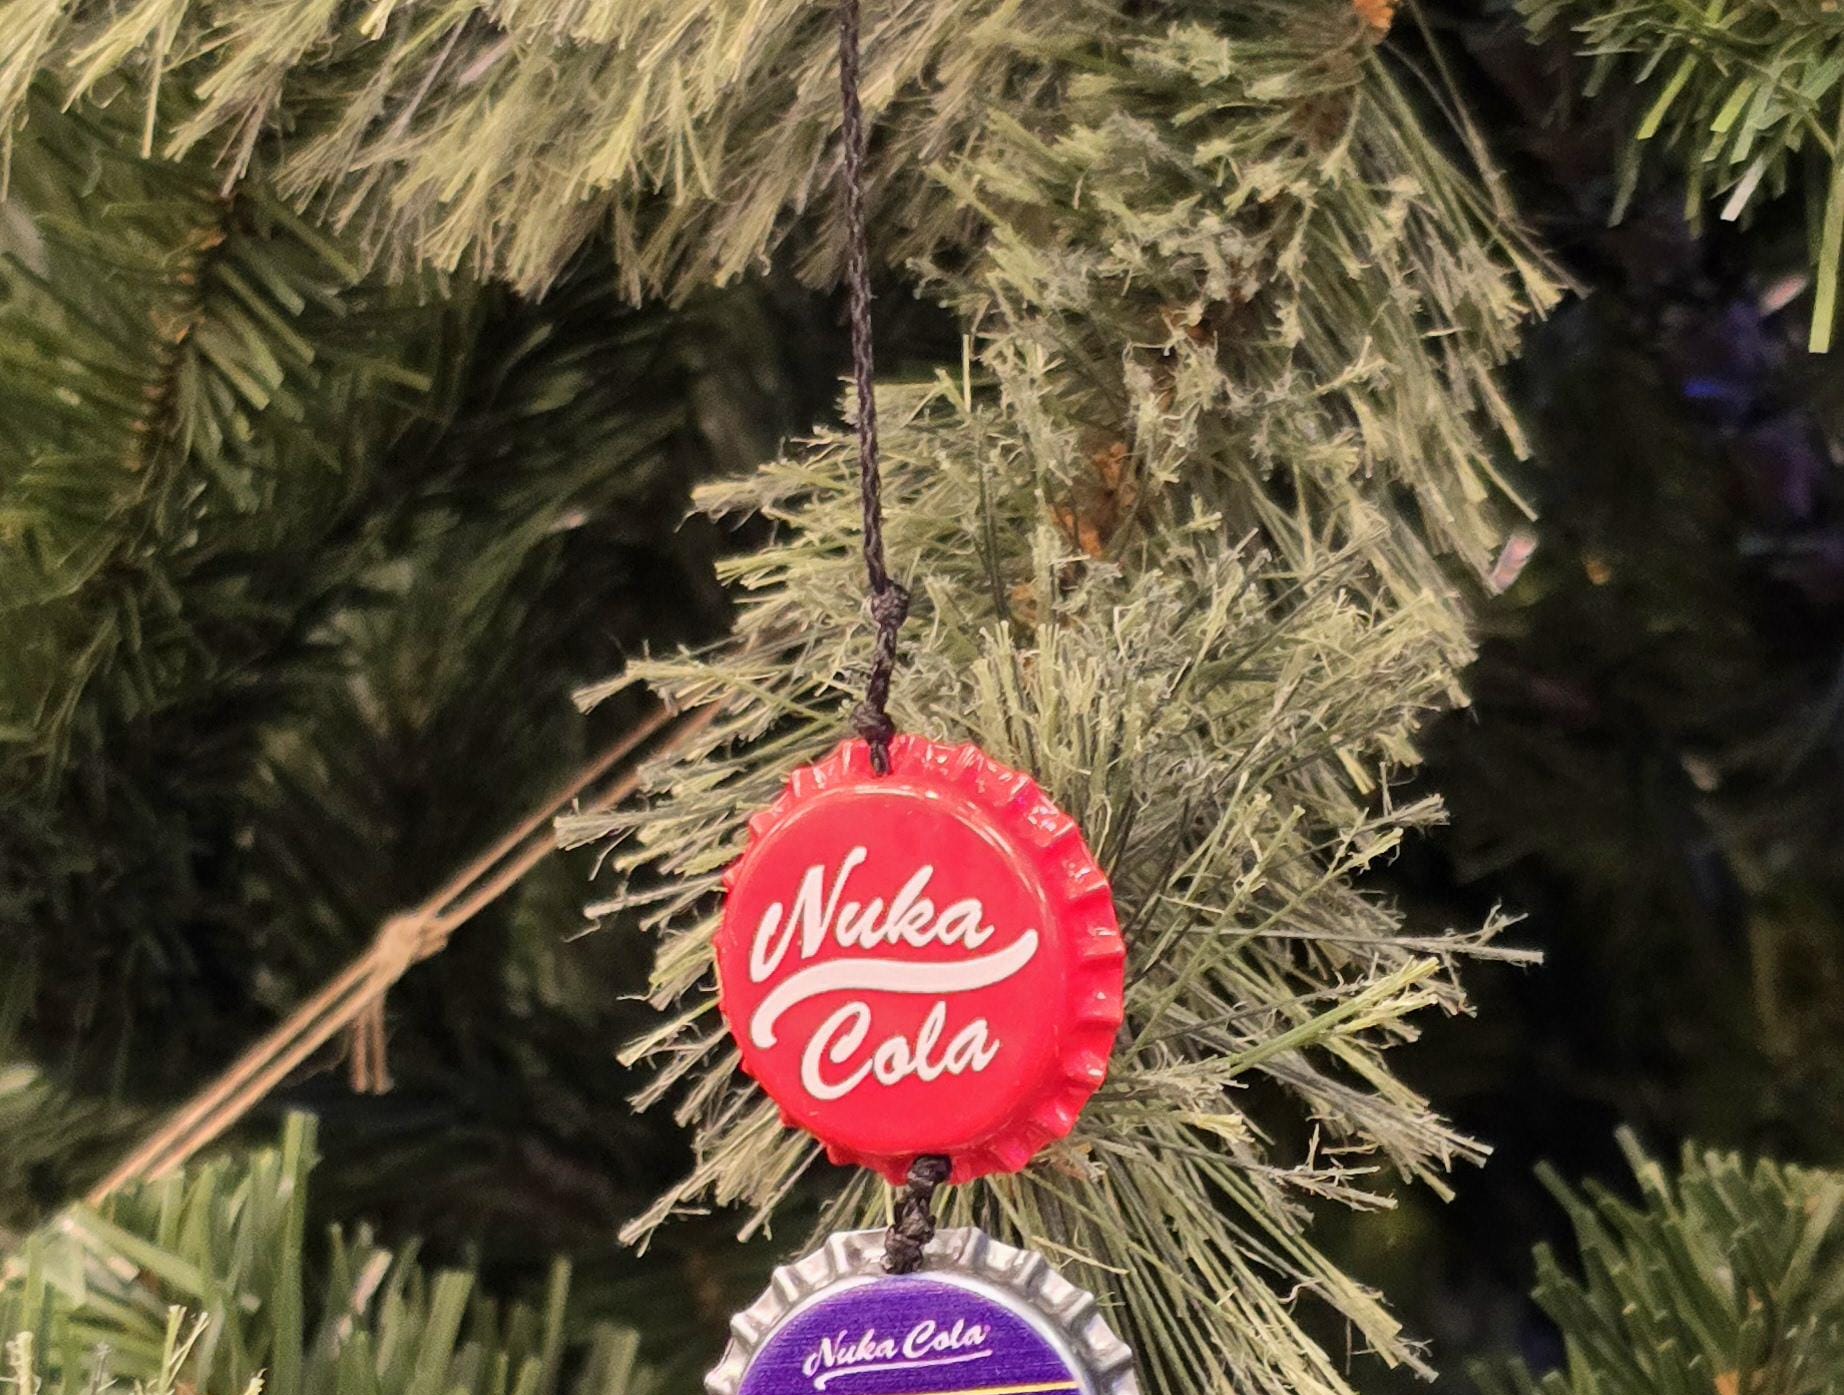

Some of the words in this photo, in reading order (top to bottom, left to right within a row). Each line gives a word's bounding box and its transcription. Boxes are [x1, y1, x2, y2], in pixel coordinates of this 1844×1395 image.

[749, 846, 995, 983] Nuka
[801, 1001, 1000, 1100] Cola
[802, 1328, 899, 1377] Nuka
[902, 1318, 992, 1359] Cola
